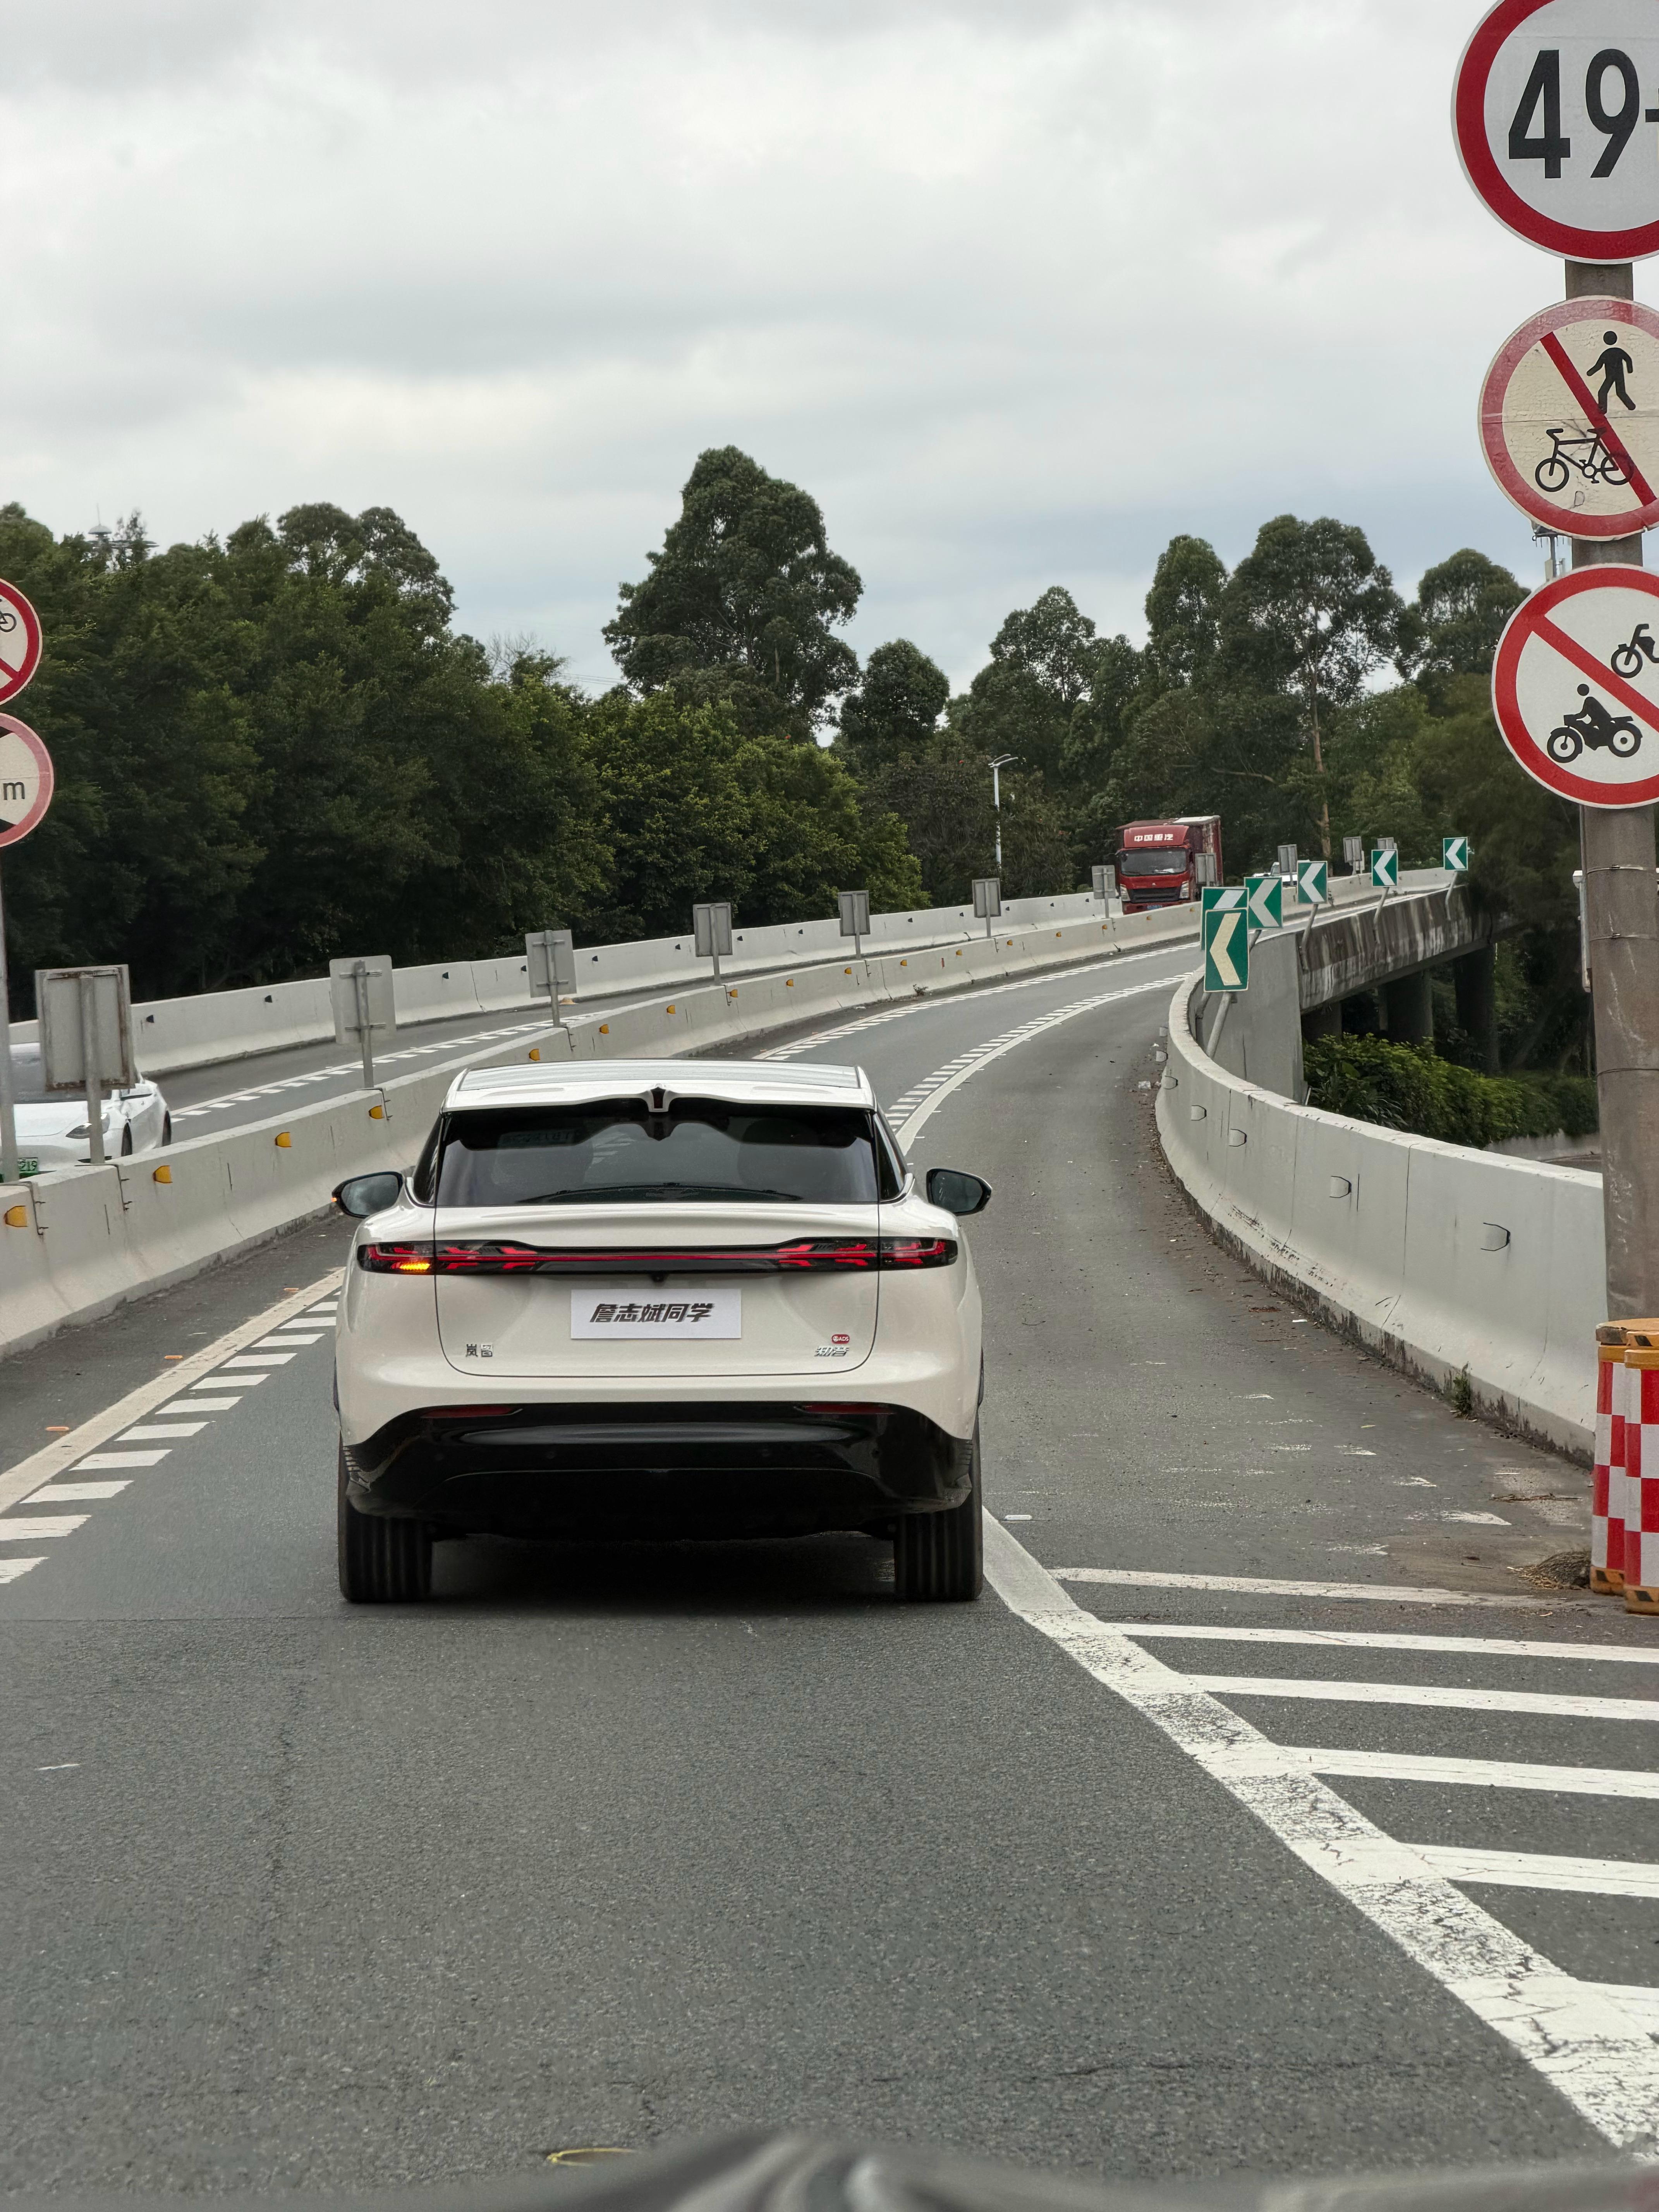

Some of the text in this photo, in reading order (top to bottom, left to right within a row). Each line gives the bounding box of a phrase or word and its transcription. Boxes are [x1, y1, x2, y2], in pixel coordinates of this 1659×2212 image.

[3, 781, 25, 800] m
[589, 1303, 715, 1323] 詹志斌同学
